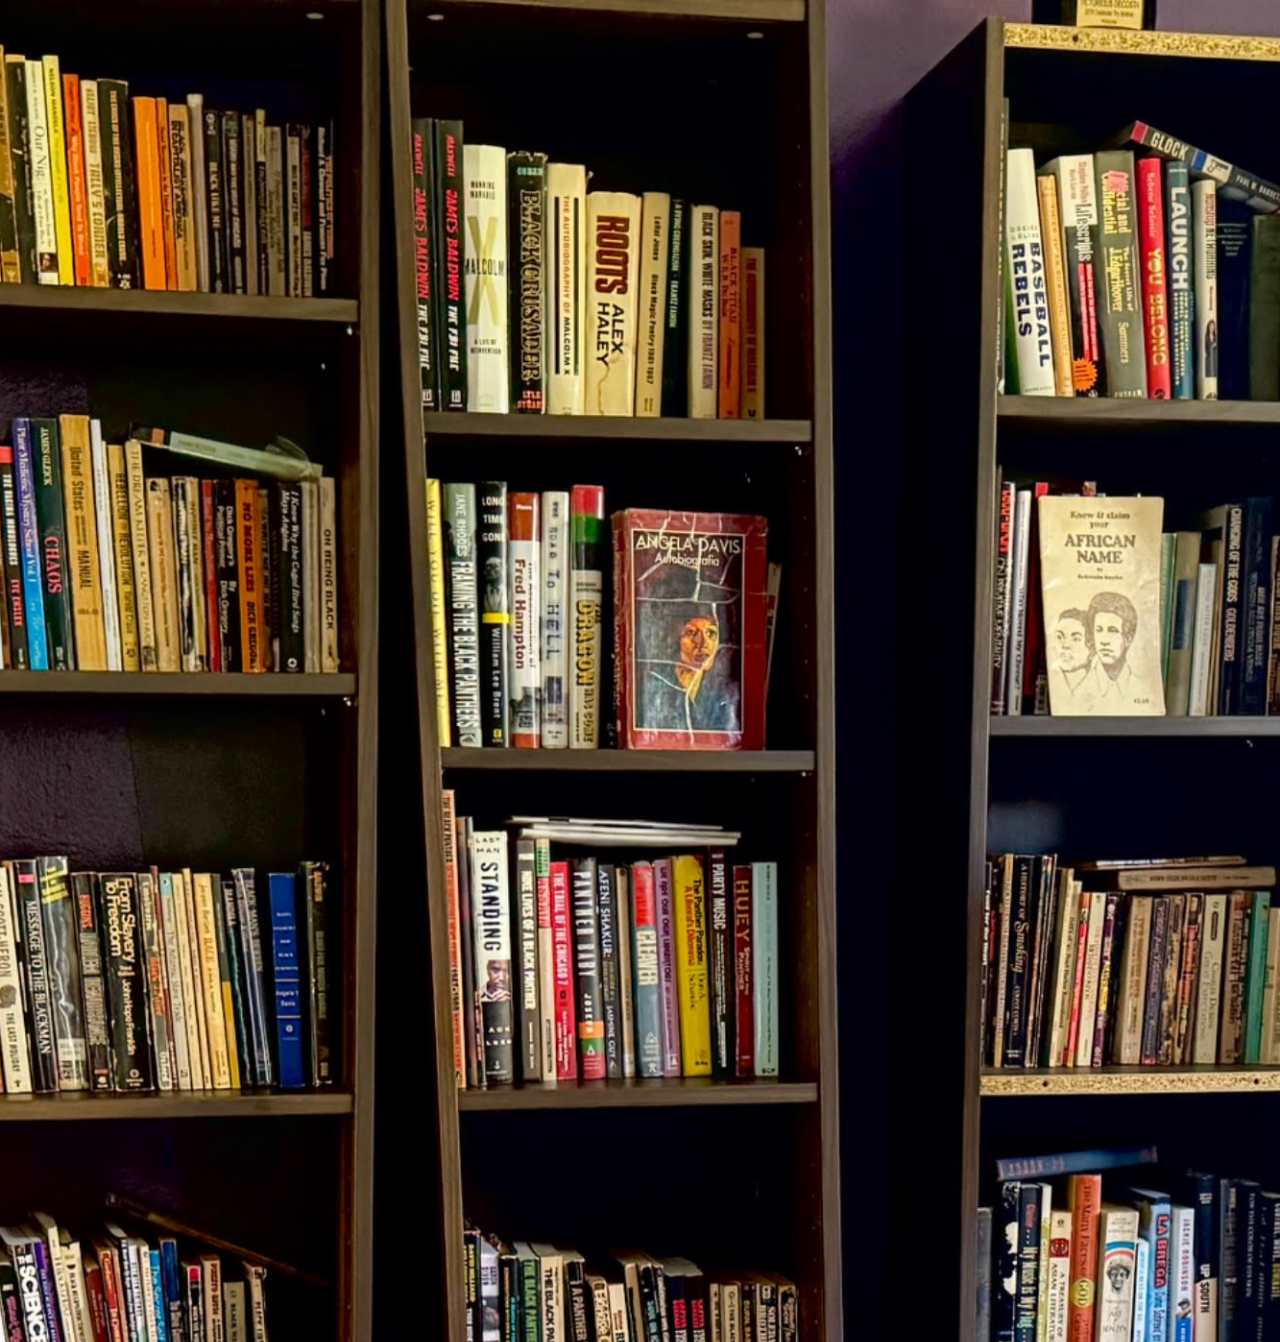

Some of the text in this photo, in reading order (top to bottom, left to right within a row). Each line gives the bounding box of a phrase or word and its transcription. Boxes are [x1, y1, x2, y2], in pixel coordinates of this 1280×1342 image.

[1149, 132, 1185, 161] GLOCK
[595, 216, 629, 294] ROOTS
[1170, 186, 1189, 290] LAUNCH
[520, 190, 543, 382] BLACK CRUSADER
[1011, 243, 1032, 337] REBELS
[1029, 242, 1050, 368] BASEBALL
[596, 302, 610, 368] HALEY
[610, 304, 624, 354] ALEX
[1117, 322, 1130, 363] Summers
[44, 536, 62, 593] CHAOS
[78, 550, 92, 590] MANUAL
[636, 534, 740, 553] ANGELA DAVIS
[1064, 534, 1136, 548] AFRICAN
[1076, 550, 1123, 564] NAME
[452, 495, 479, 728] JANE RHODES FRAMING THE BLACK PANTHERS
[513, 559, 527, 669] Fred Hampton
[576, 601, 596, 686] DRAGON
[480, 862, 502, 952] STANDING
[711, 864, 725, 895] PARTY
[106, 881, 123, 956] To Freedom
[119, 878, 137, 963] From Slavery
[574, 871, 596, 977] PANTHER BABY
[713, 897, 726, 930] MUSIC
[734, 880, 750, 942] HUEY
[637, 930, 659, 986] CLEAVER
[1012, 921, 1030, 973] Smoking
[26, 900, 51, 1054] MESSAGE TO THE BLACKMAN
[544, 1268, 555, 1289] THE
[545, 1290, 556, 1325] BLACK
[1199, 1264, 1211, 1313] UP SOUTH
